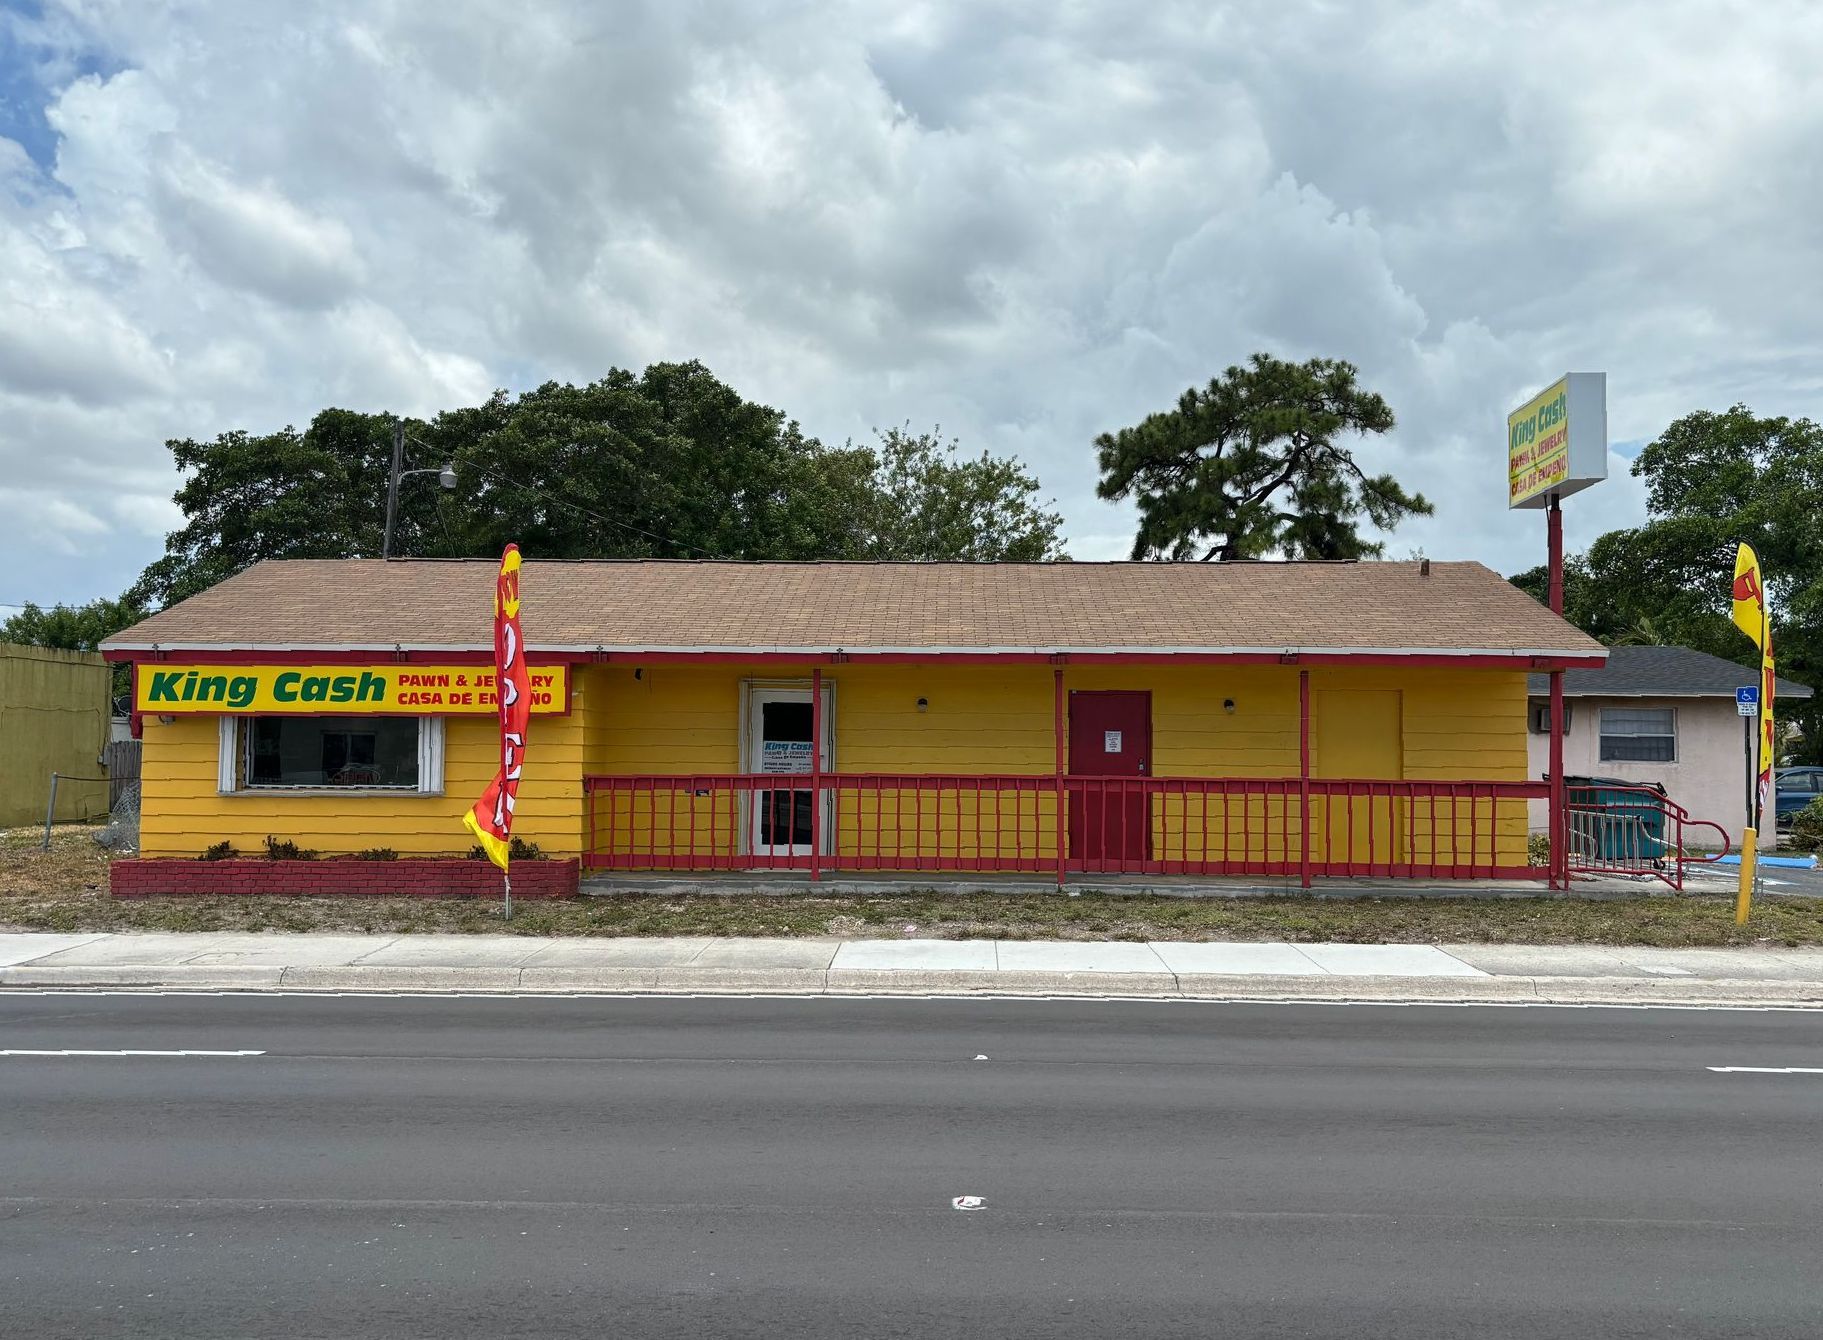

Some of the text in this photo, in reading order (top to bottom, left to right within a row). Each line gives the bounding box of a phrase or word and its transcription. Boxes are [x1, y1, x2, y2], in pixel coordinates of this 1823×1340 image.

[1511, 392, 1567, 450] King Cash
[1511, 450, 1530, 473] PAWN
[1538, 427, 1567, 458] JEWELRY
[148, 671, 387, 707] King Cash
[398, 674, 554, 687] PAWN & JERY
[397, 690, 552, 705] CASA DE EMÑO
[765, 742, 789, 751] King
